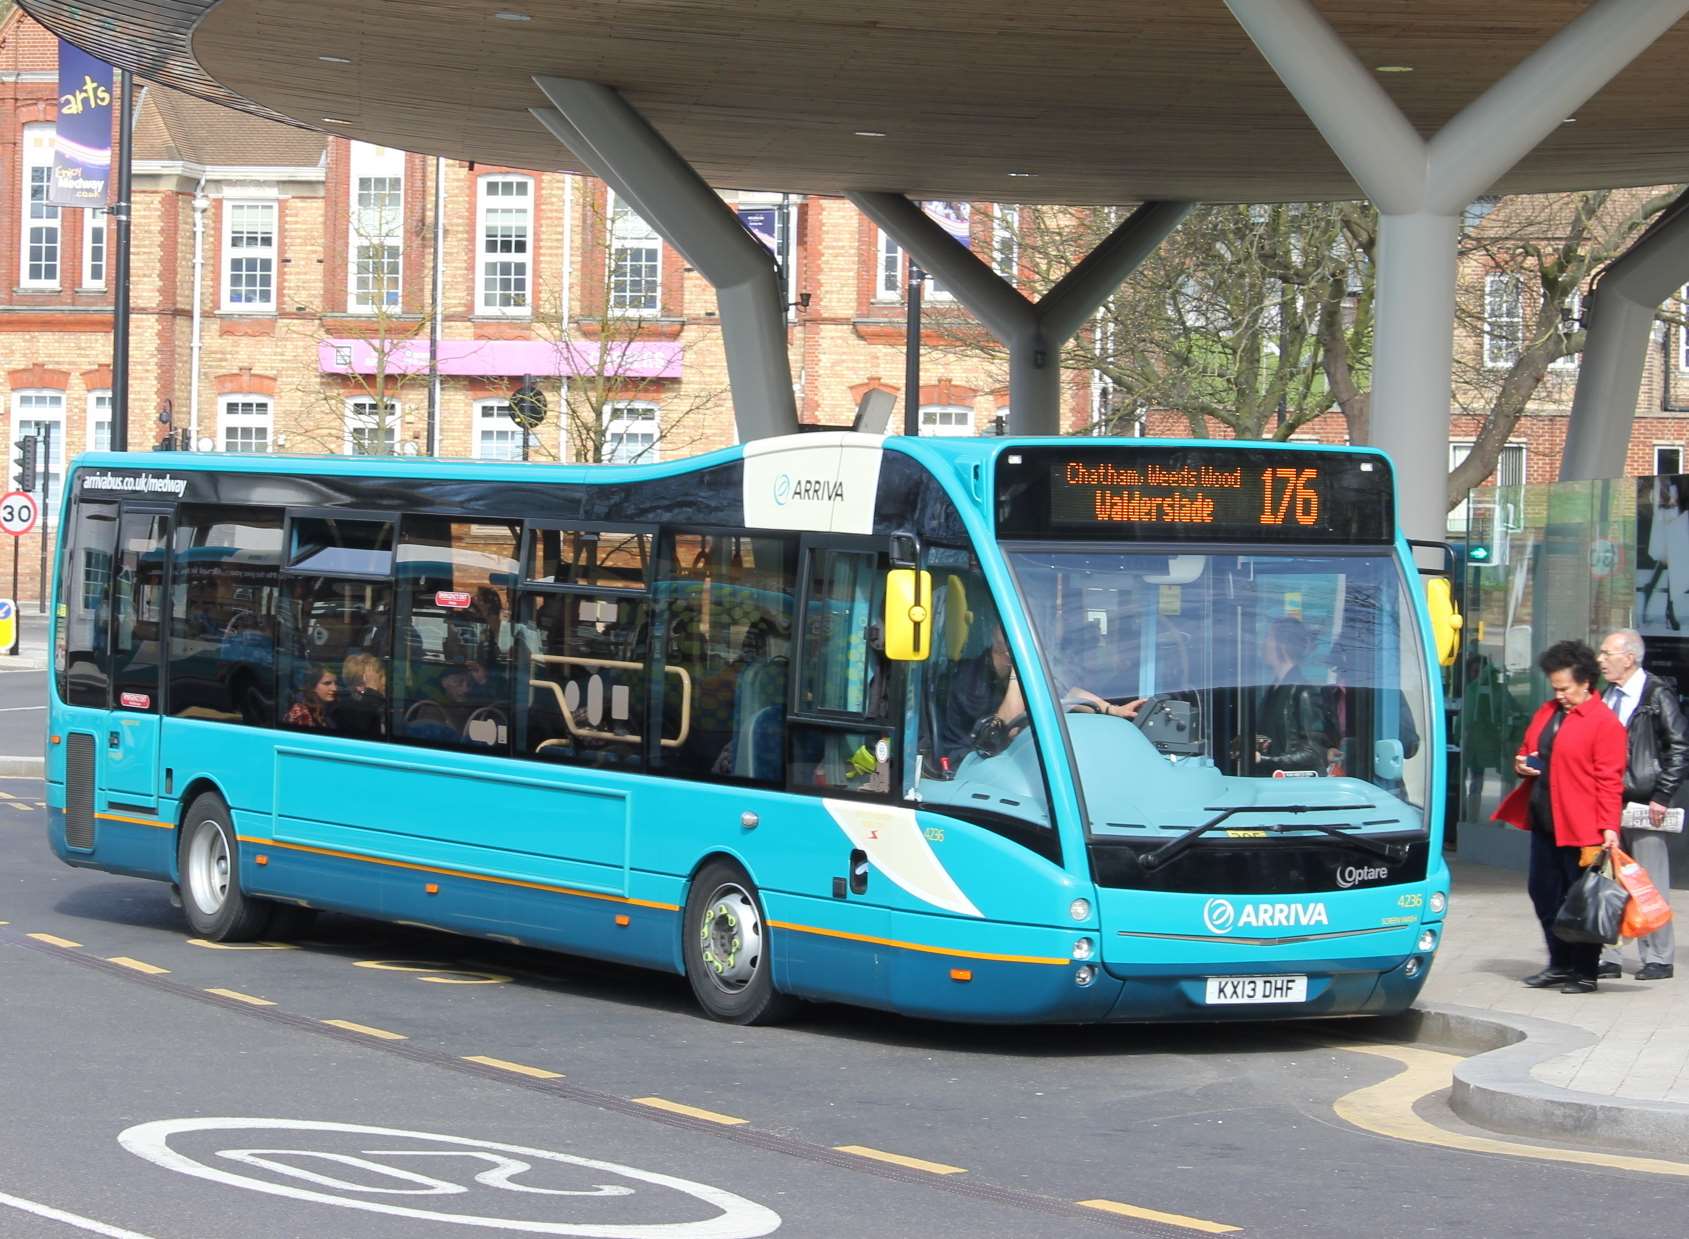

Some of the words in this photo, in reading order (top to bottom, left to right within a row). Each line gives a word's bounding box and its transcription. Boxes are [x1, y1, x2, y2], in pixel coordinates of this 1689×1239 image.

[60, 75, 111, 114] arts
[83, 472, 188, 498] arrivabus.co.uk/medway
[1147, 464, 1198, 487] Weeds
[1201, 466, 1242, 488] Wood
[791, 479, 844, 502] ARRIVA
[1260, 468, 1319, 525] 176
[2, 504, 32, 523] 30
[1095, 490, 1215, 523] Walderslade
[923, 826, 945, 842] 4236
[1340, 866, 1389, 886] Optare
[1398, 894, 1423, 908] 4236
[1237, 902, 1329, 927] ARRIVA
[1217, 980, 1257, 999] KX13
[1262, 979, 1296, 998] DHF
